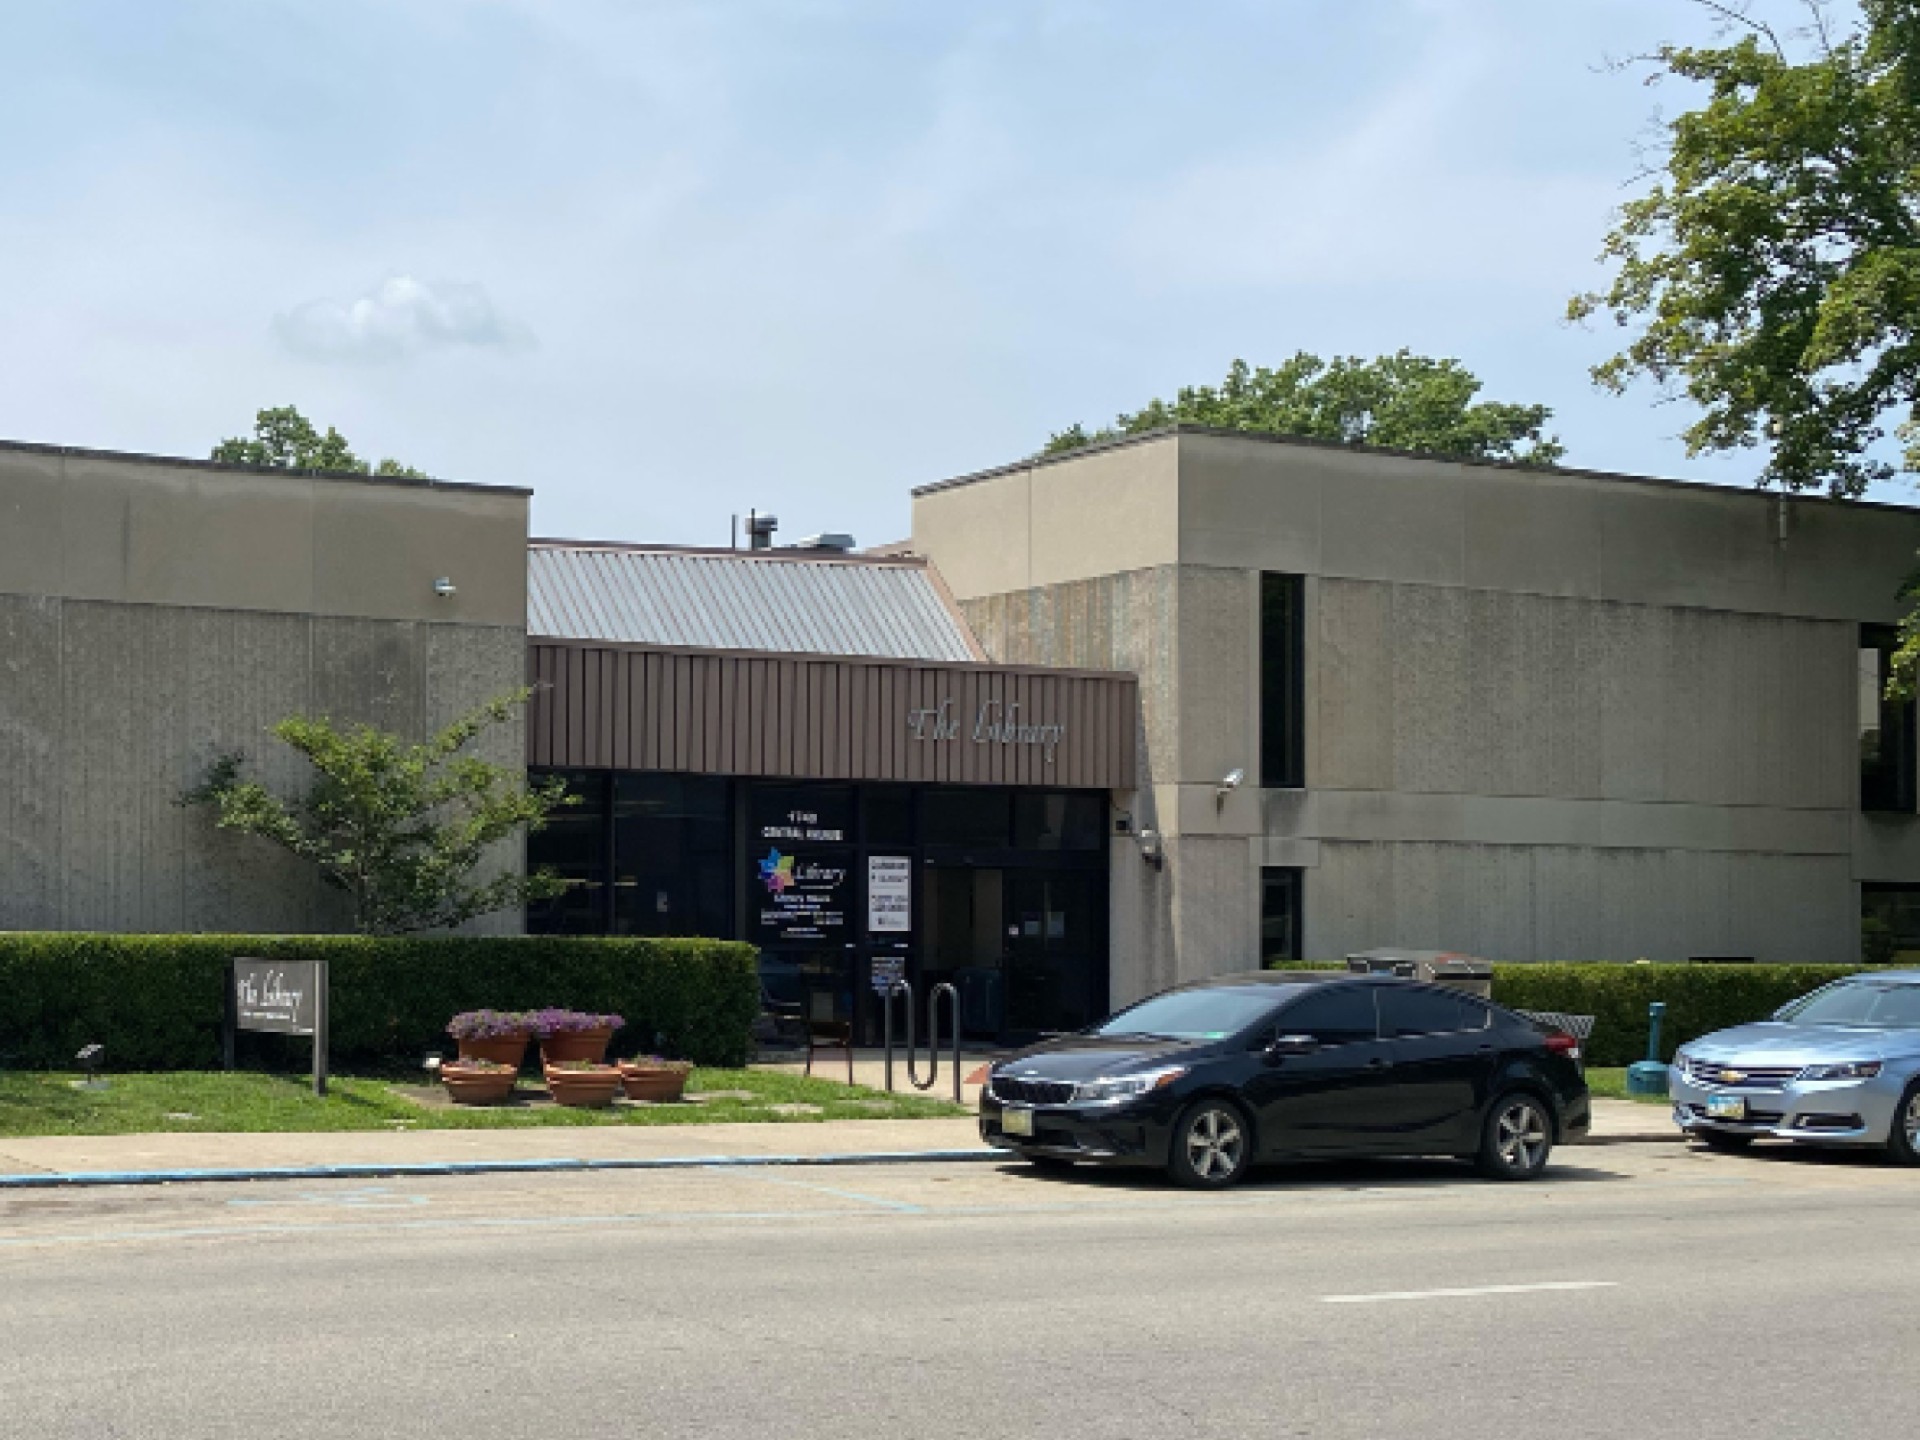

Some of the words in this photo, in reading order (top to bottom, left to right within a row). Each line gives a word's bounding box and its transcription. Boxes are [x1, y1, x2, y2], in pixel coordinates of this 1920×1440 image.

[908, 697, 960, 740] The
[972, 700, 1065, 763] Library
[796, 863, 846, 886] Library
[260, 969, 303, 1023] Library
